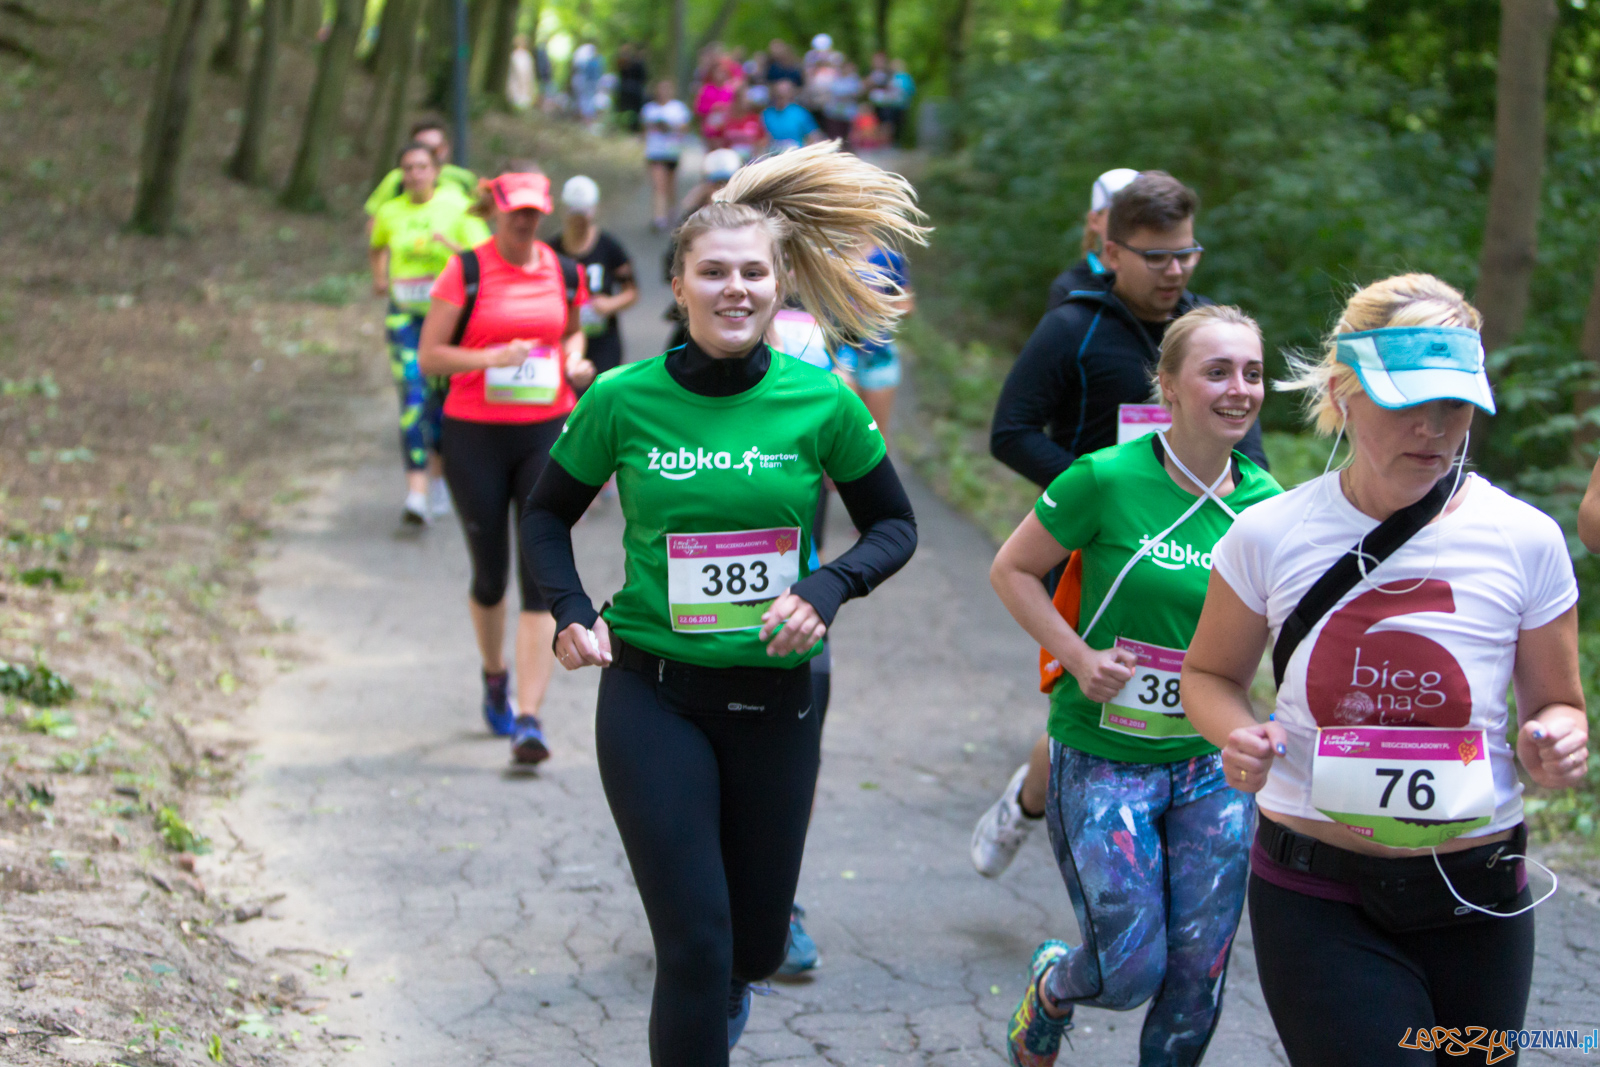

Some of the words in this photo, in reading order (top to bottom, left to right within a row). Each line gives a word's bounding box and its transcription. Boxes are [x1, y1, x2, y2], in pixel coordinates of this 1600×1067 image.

[648, 447, 731, 470] żabka
[759, 453, 798, 462] sportowy
[701, 560, 769, 597] 383
[1350, 647, 1447, 708] bieg
[1377, 693, 1412, 711] na
[1375, 768, 1436, 811] 76
